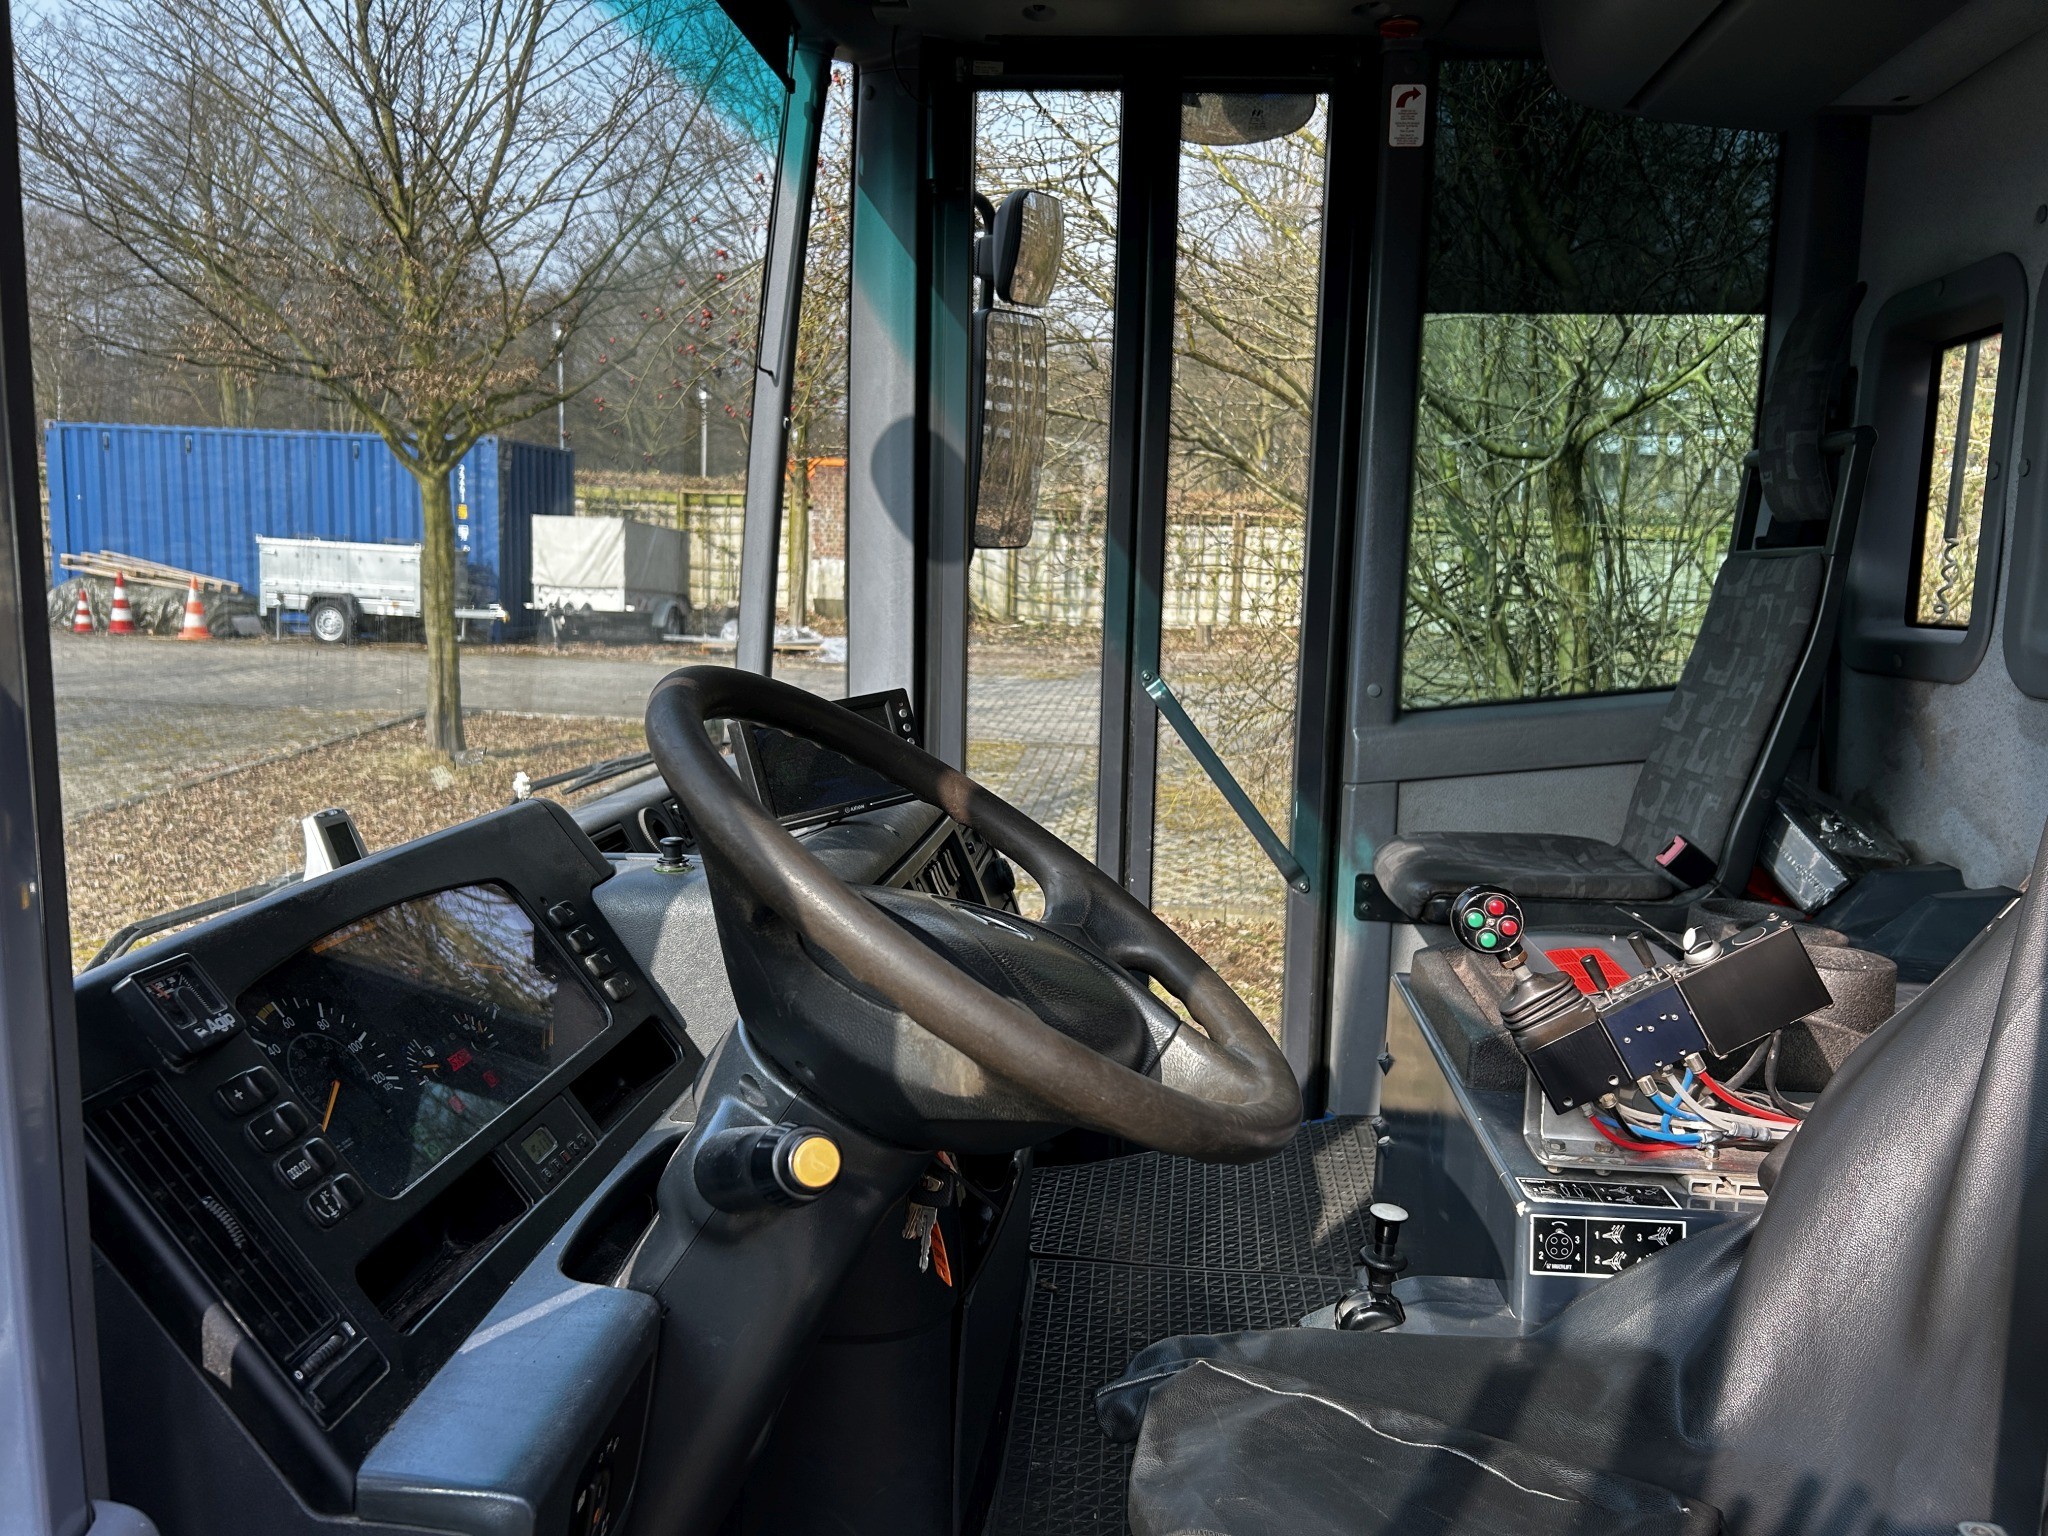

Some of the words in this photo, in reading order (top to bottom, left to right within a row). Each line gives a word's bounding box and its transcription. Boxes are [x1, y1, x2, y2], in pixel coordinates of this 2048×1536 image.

[205, 1012, 236, 1034] Agip
[282, 1017, 296, 1030] 60
[316, 1018, 330, 1030] 80
[267, 1043, 281, 1056] 40
[347, 1040, 363, 1054] 100
[371, 1071, 386, 1085] 120
[1538, 1233, 1543, 1243] 1
[1574, 1236, 1580, 1244] 3
[1594, 1231, 1600, 1240] 1
[1636, 1233, 1643, 1242] 3
[1538, 1251, 1544, 1260] 2
[1574, 1253, 1581, 1262] 4
[1594, 1255, 1601, 1265] 2
